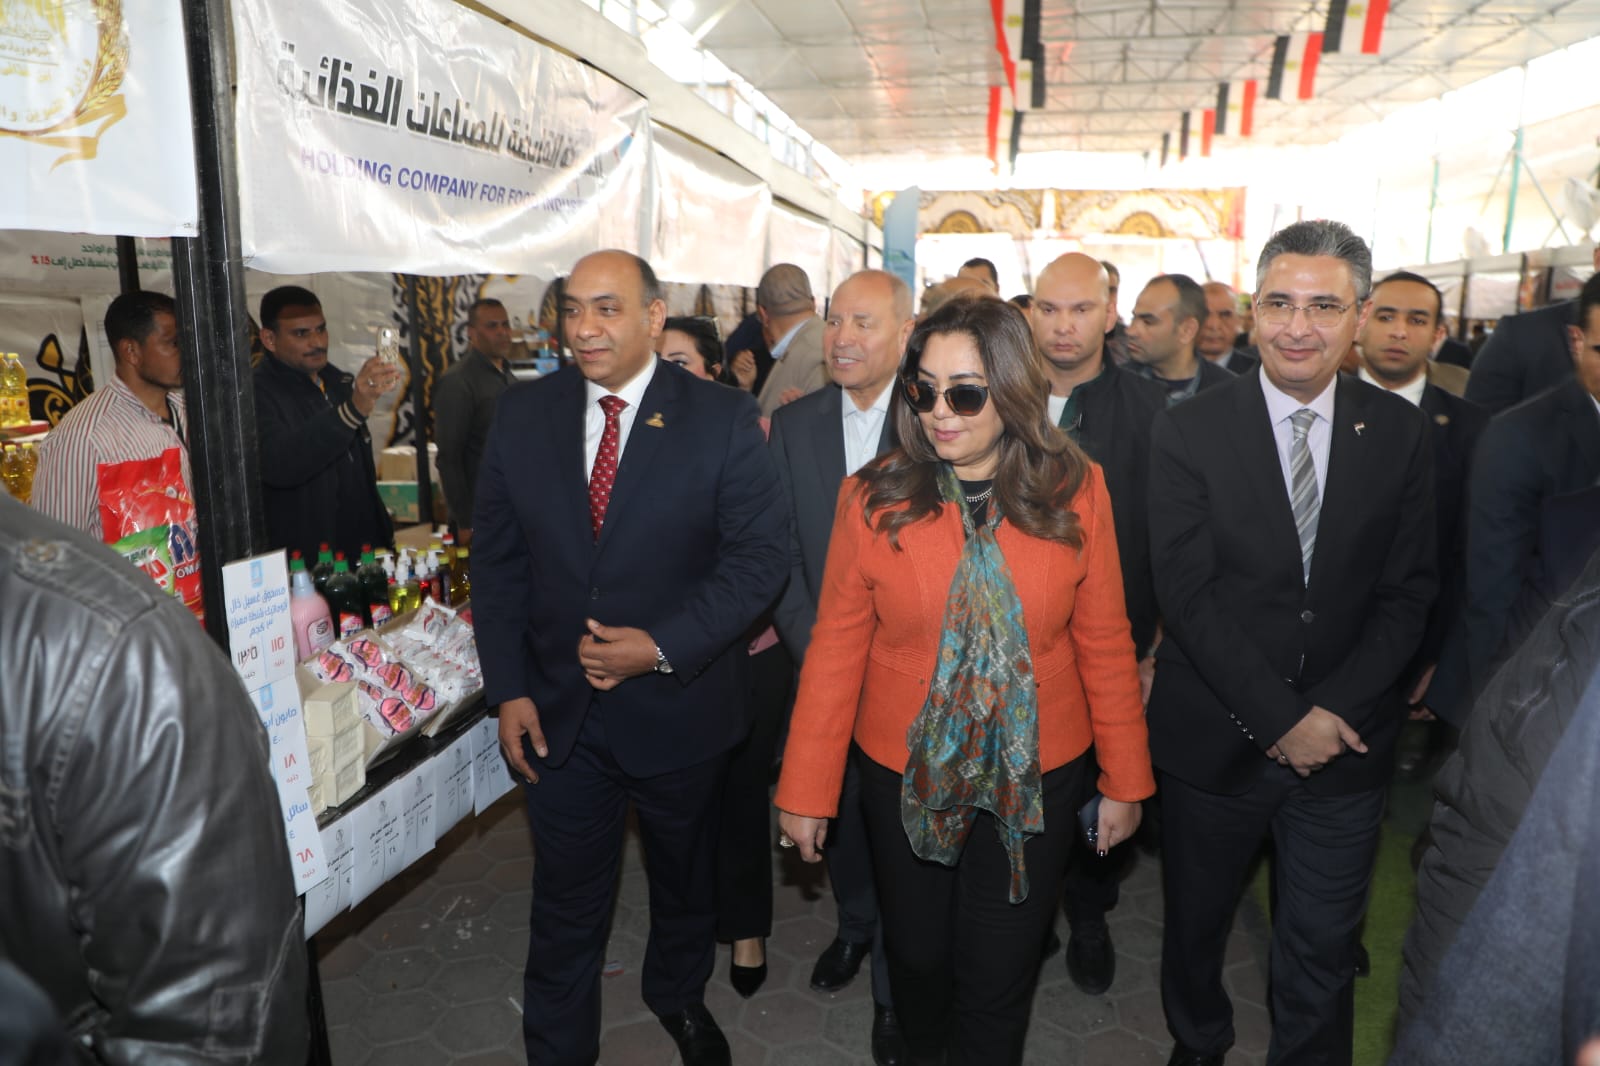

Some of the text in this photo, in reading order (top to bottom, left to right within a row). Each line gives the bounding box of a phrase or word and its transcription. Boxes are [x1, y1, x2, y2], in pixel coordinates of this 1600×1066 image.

[277, 41, 403, 127] الغذائية
[405, 92, 505, 154] للصناعات
[300, 147, 391, 185] HOLDING
[397, 167, 478, 200] COMPANY
[479, 184, 506, 205] FOR
